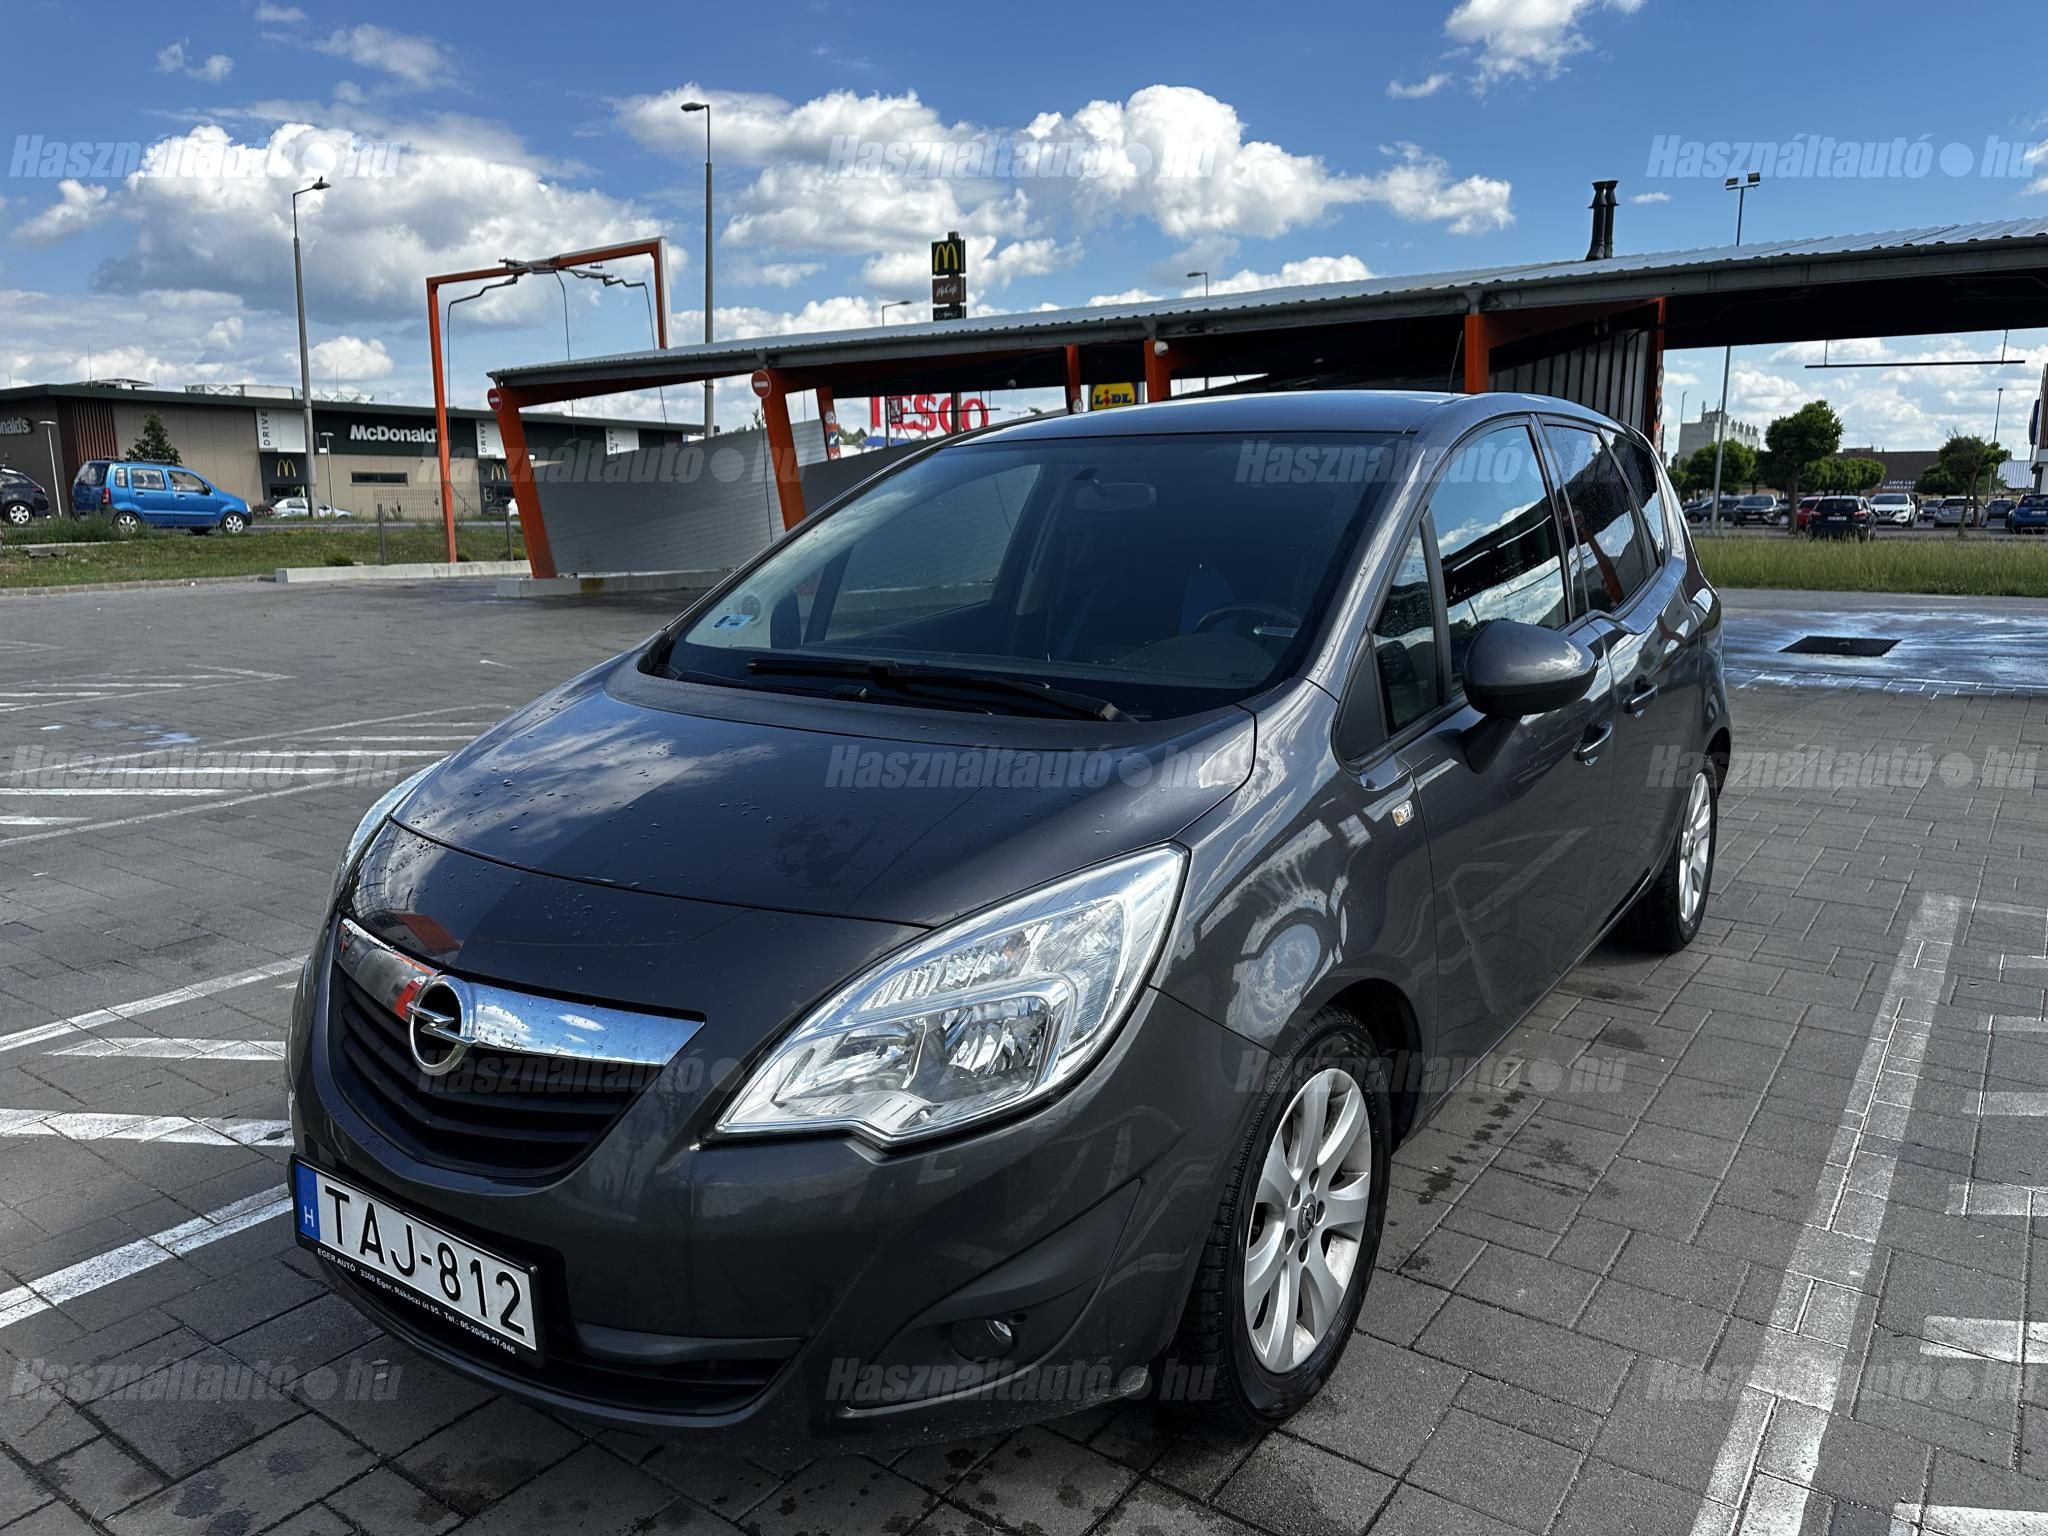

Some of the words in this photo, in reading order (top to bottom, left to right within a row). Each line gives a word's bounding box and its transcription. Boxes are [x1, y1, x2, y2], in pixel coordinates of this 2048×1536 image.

[260, 409, 271, 446] DRIVE
[304, 1205, 314, 1227] H
[317, 1248, 336, 1263] EGER
[325, 1184, 526, 1336] TAJ-812
